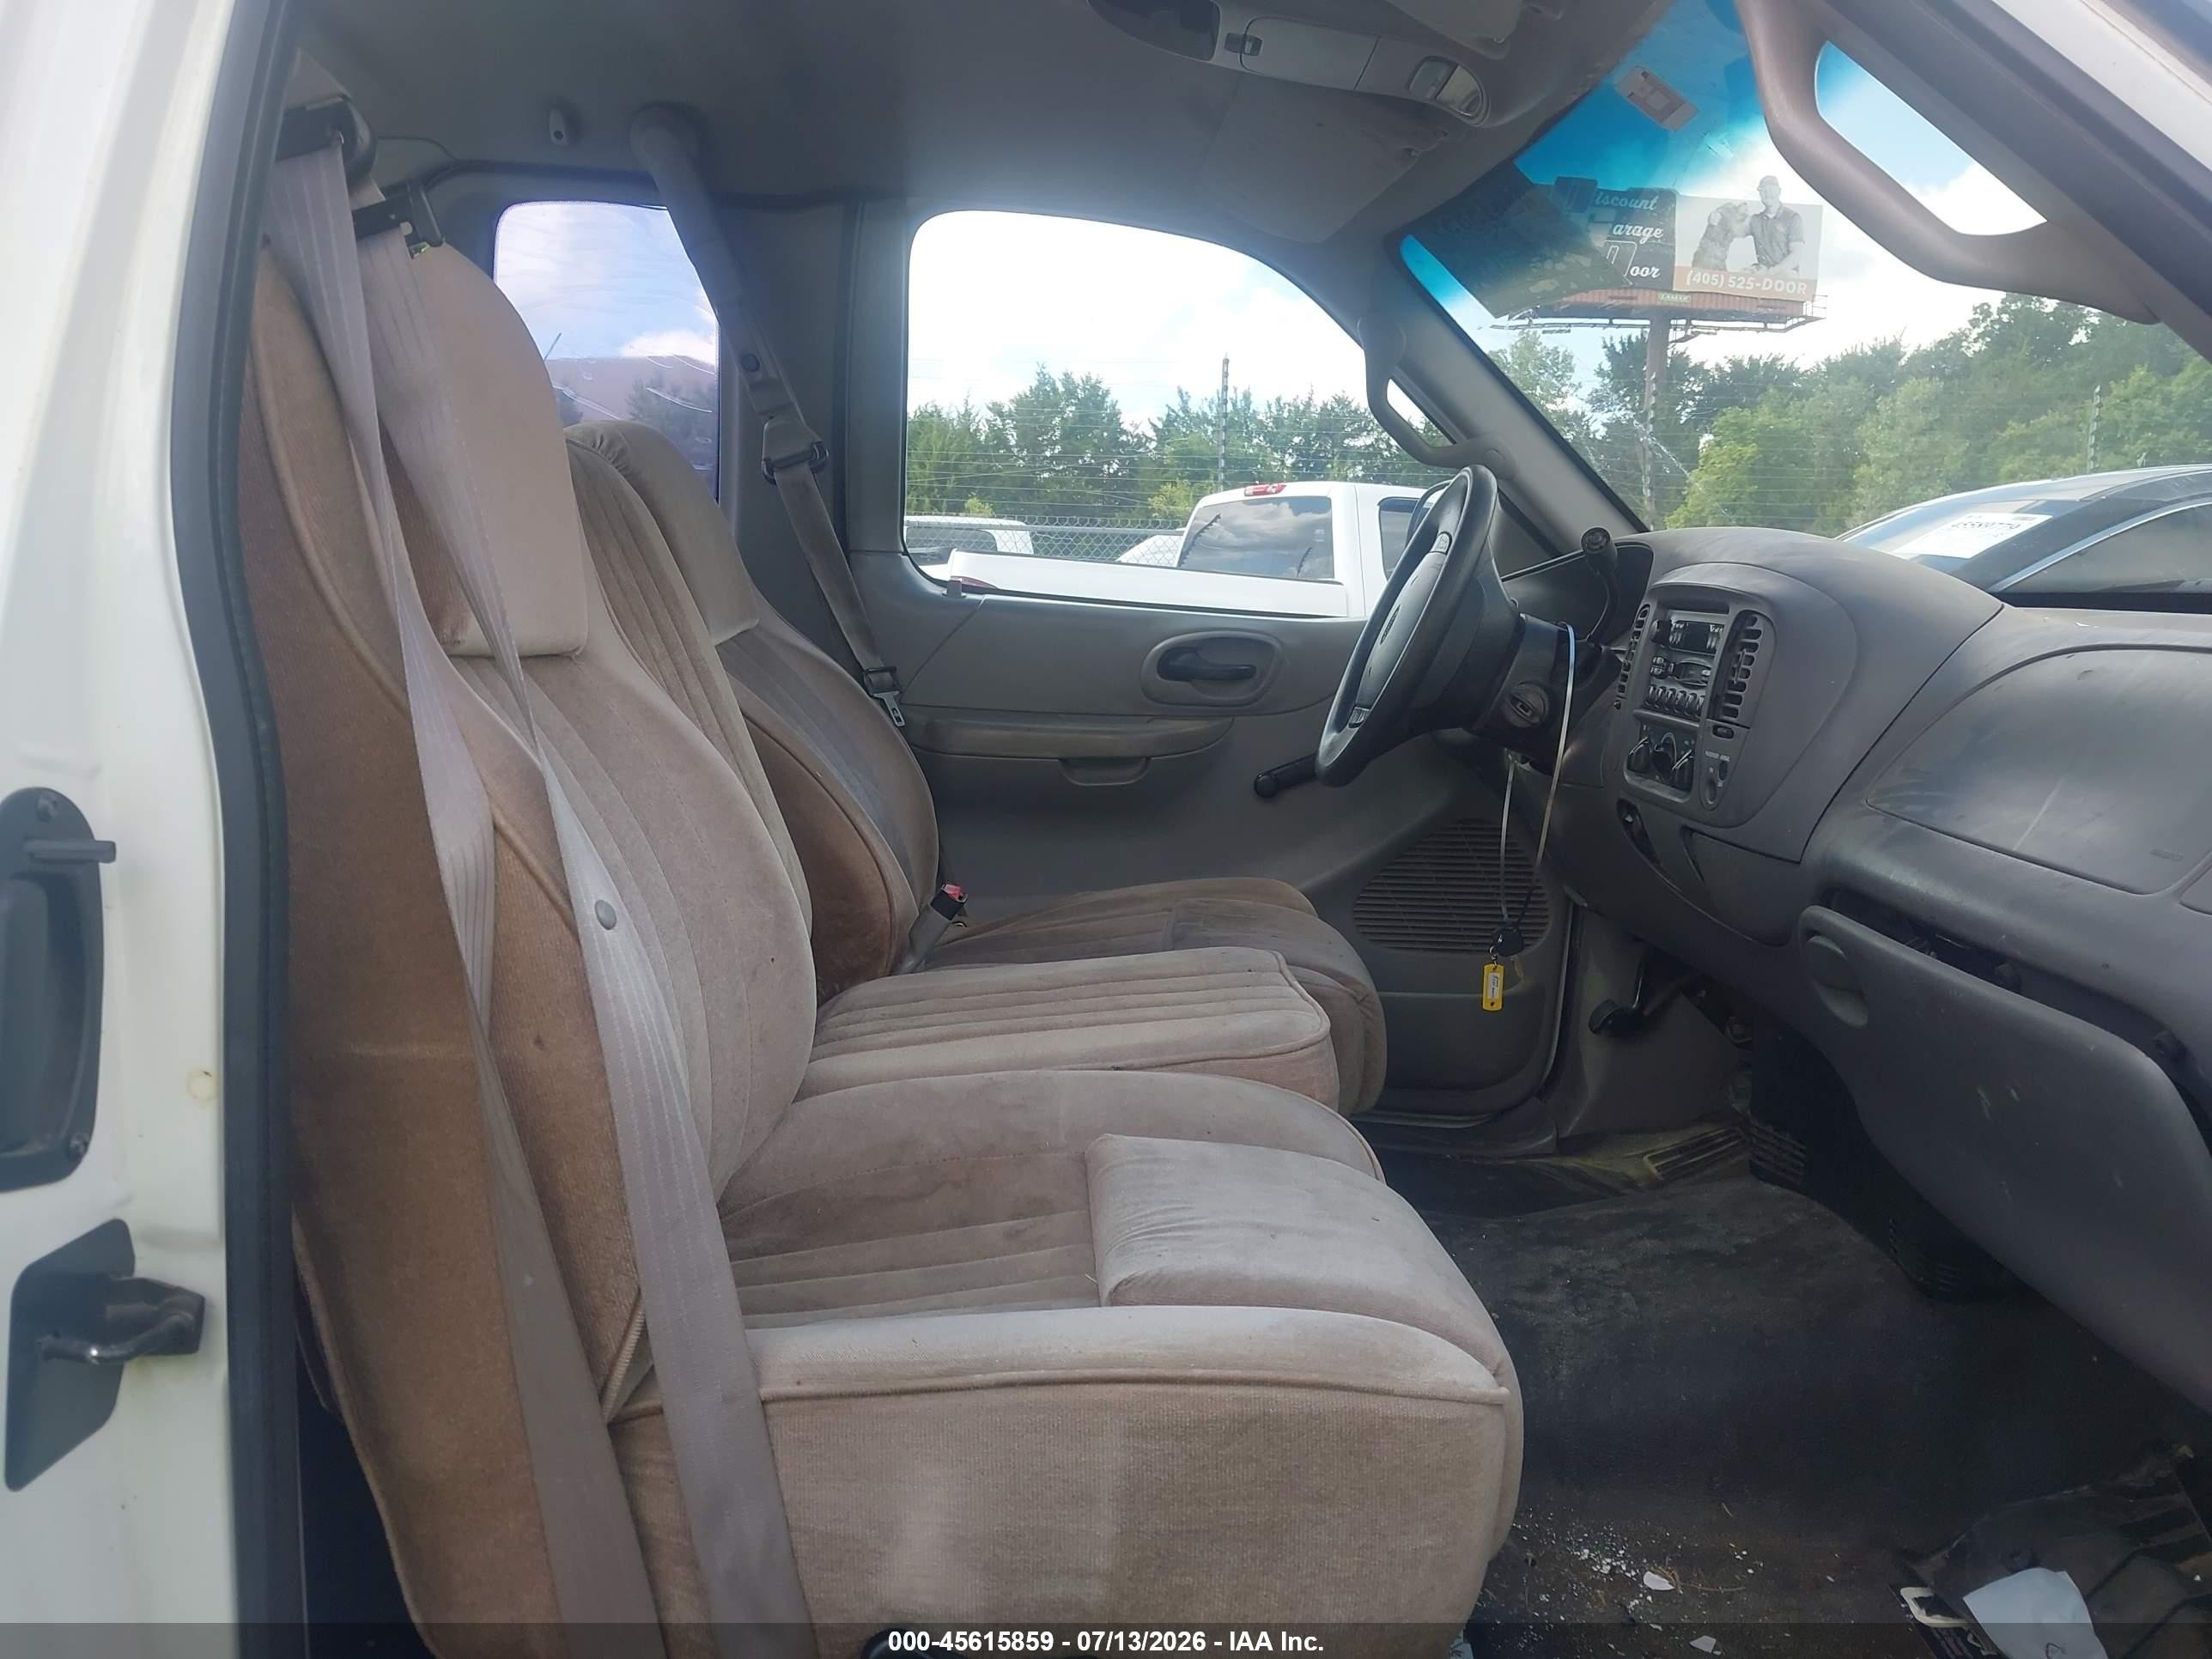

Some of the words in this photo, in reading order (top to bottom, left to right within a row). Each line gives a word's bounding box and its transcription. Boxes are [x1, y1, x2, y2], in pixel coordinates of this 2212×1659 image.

[1613, 223, 1664, 245] arage
[1686, 270, 1725, 289] (405)
[1728, 276, 1808, 295] 525-DOOR
